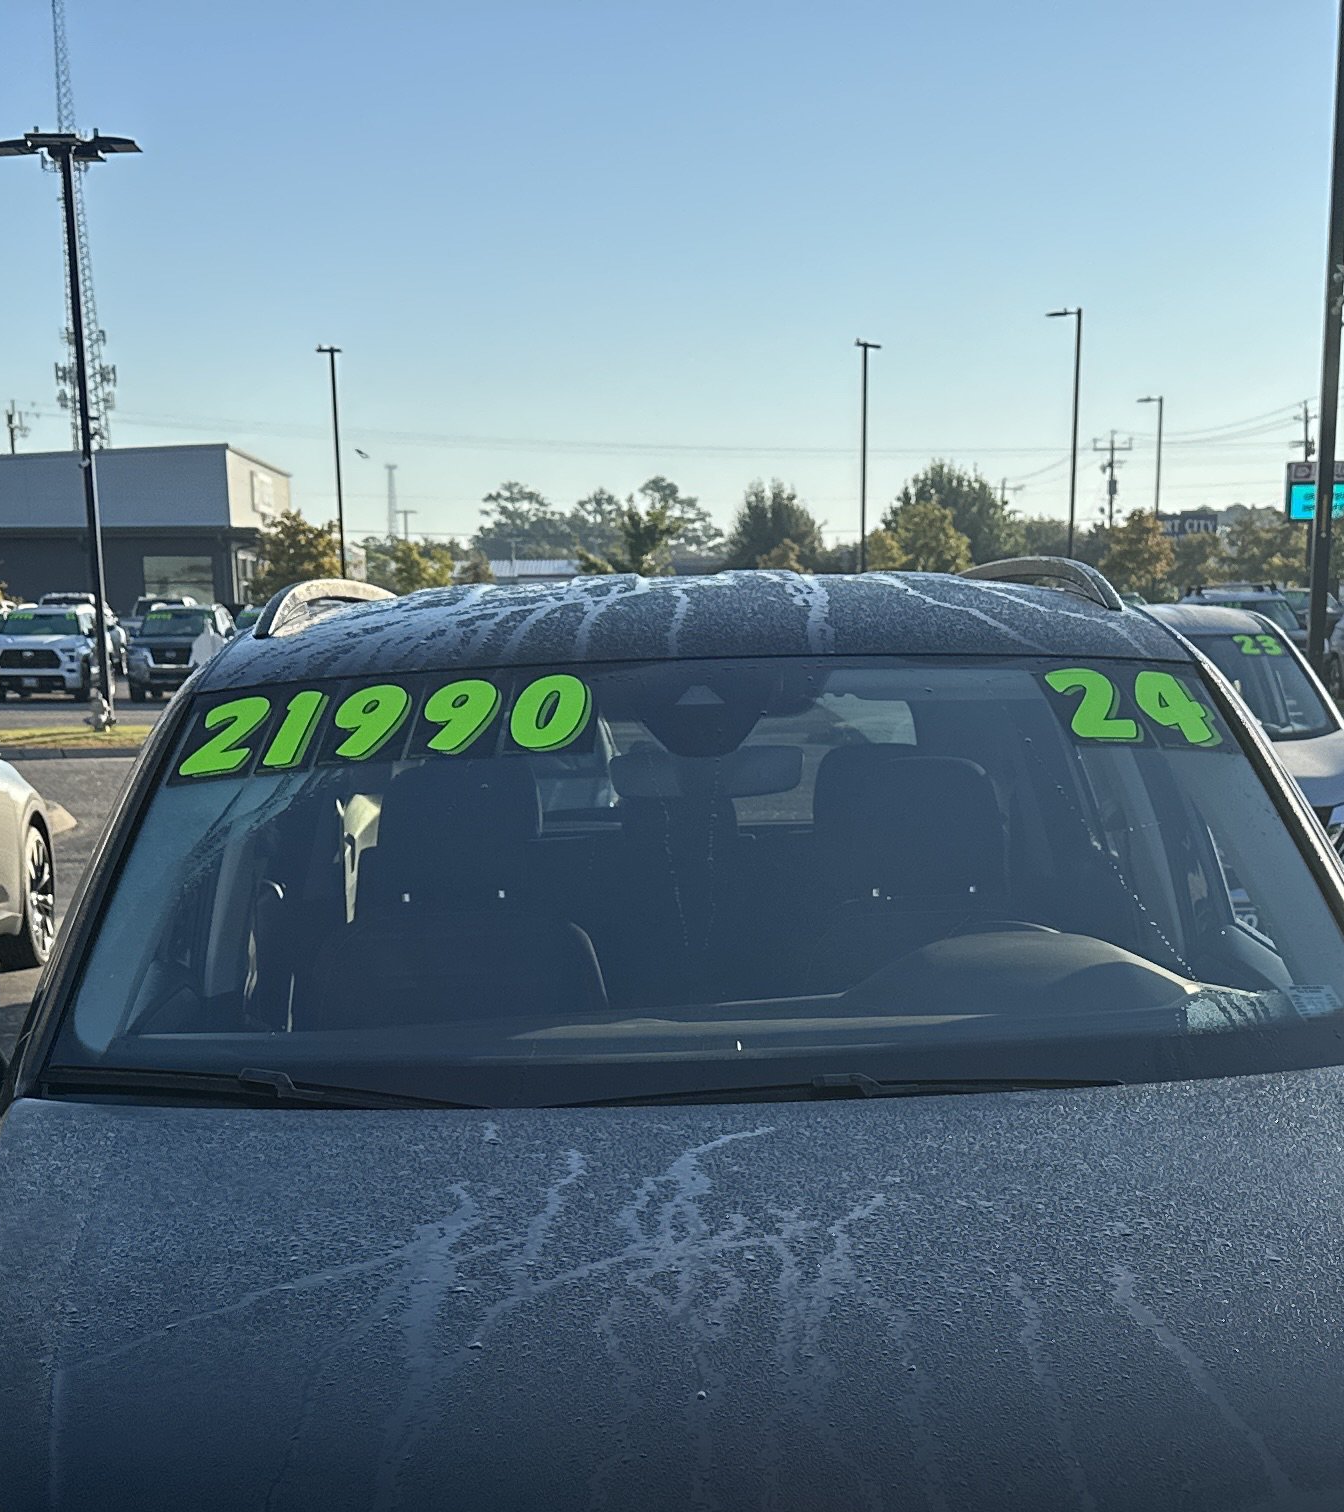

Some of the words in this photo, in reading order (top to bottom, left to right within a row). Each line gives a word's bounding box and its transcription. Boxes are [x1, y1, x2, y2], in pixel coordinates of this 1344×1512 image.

[1232, 635, 1282, 656] 23
[178, 674, 593, 778] 21990
[1044, 667, 1224, 748] 24
